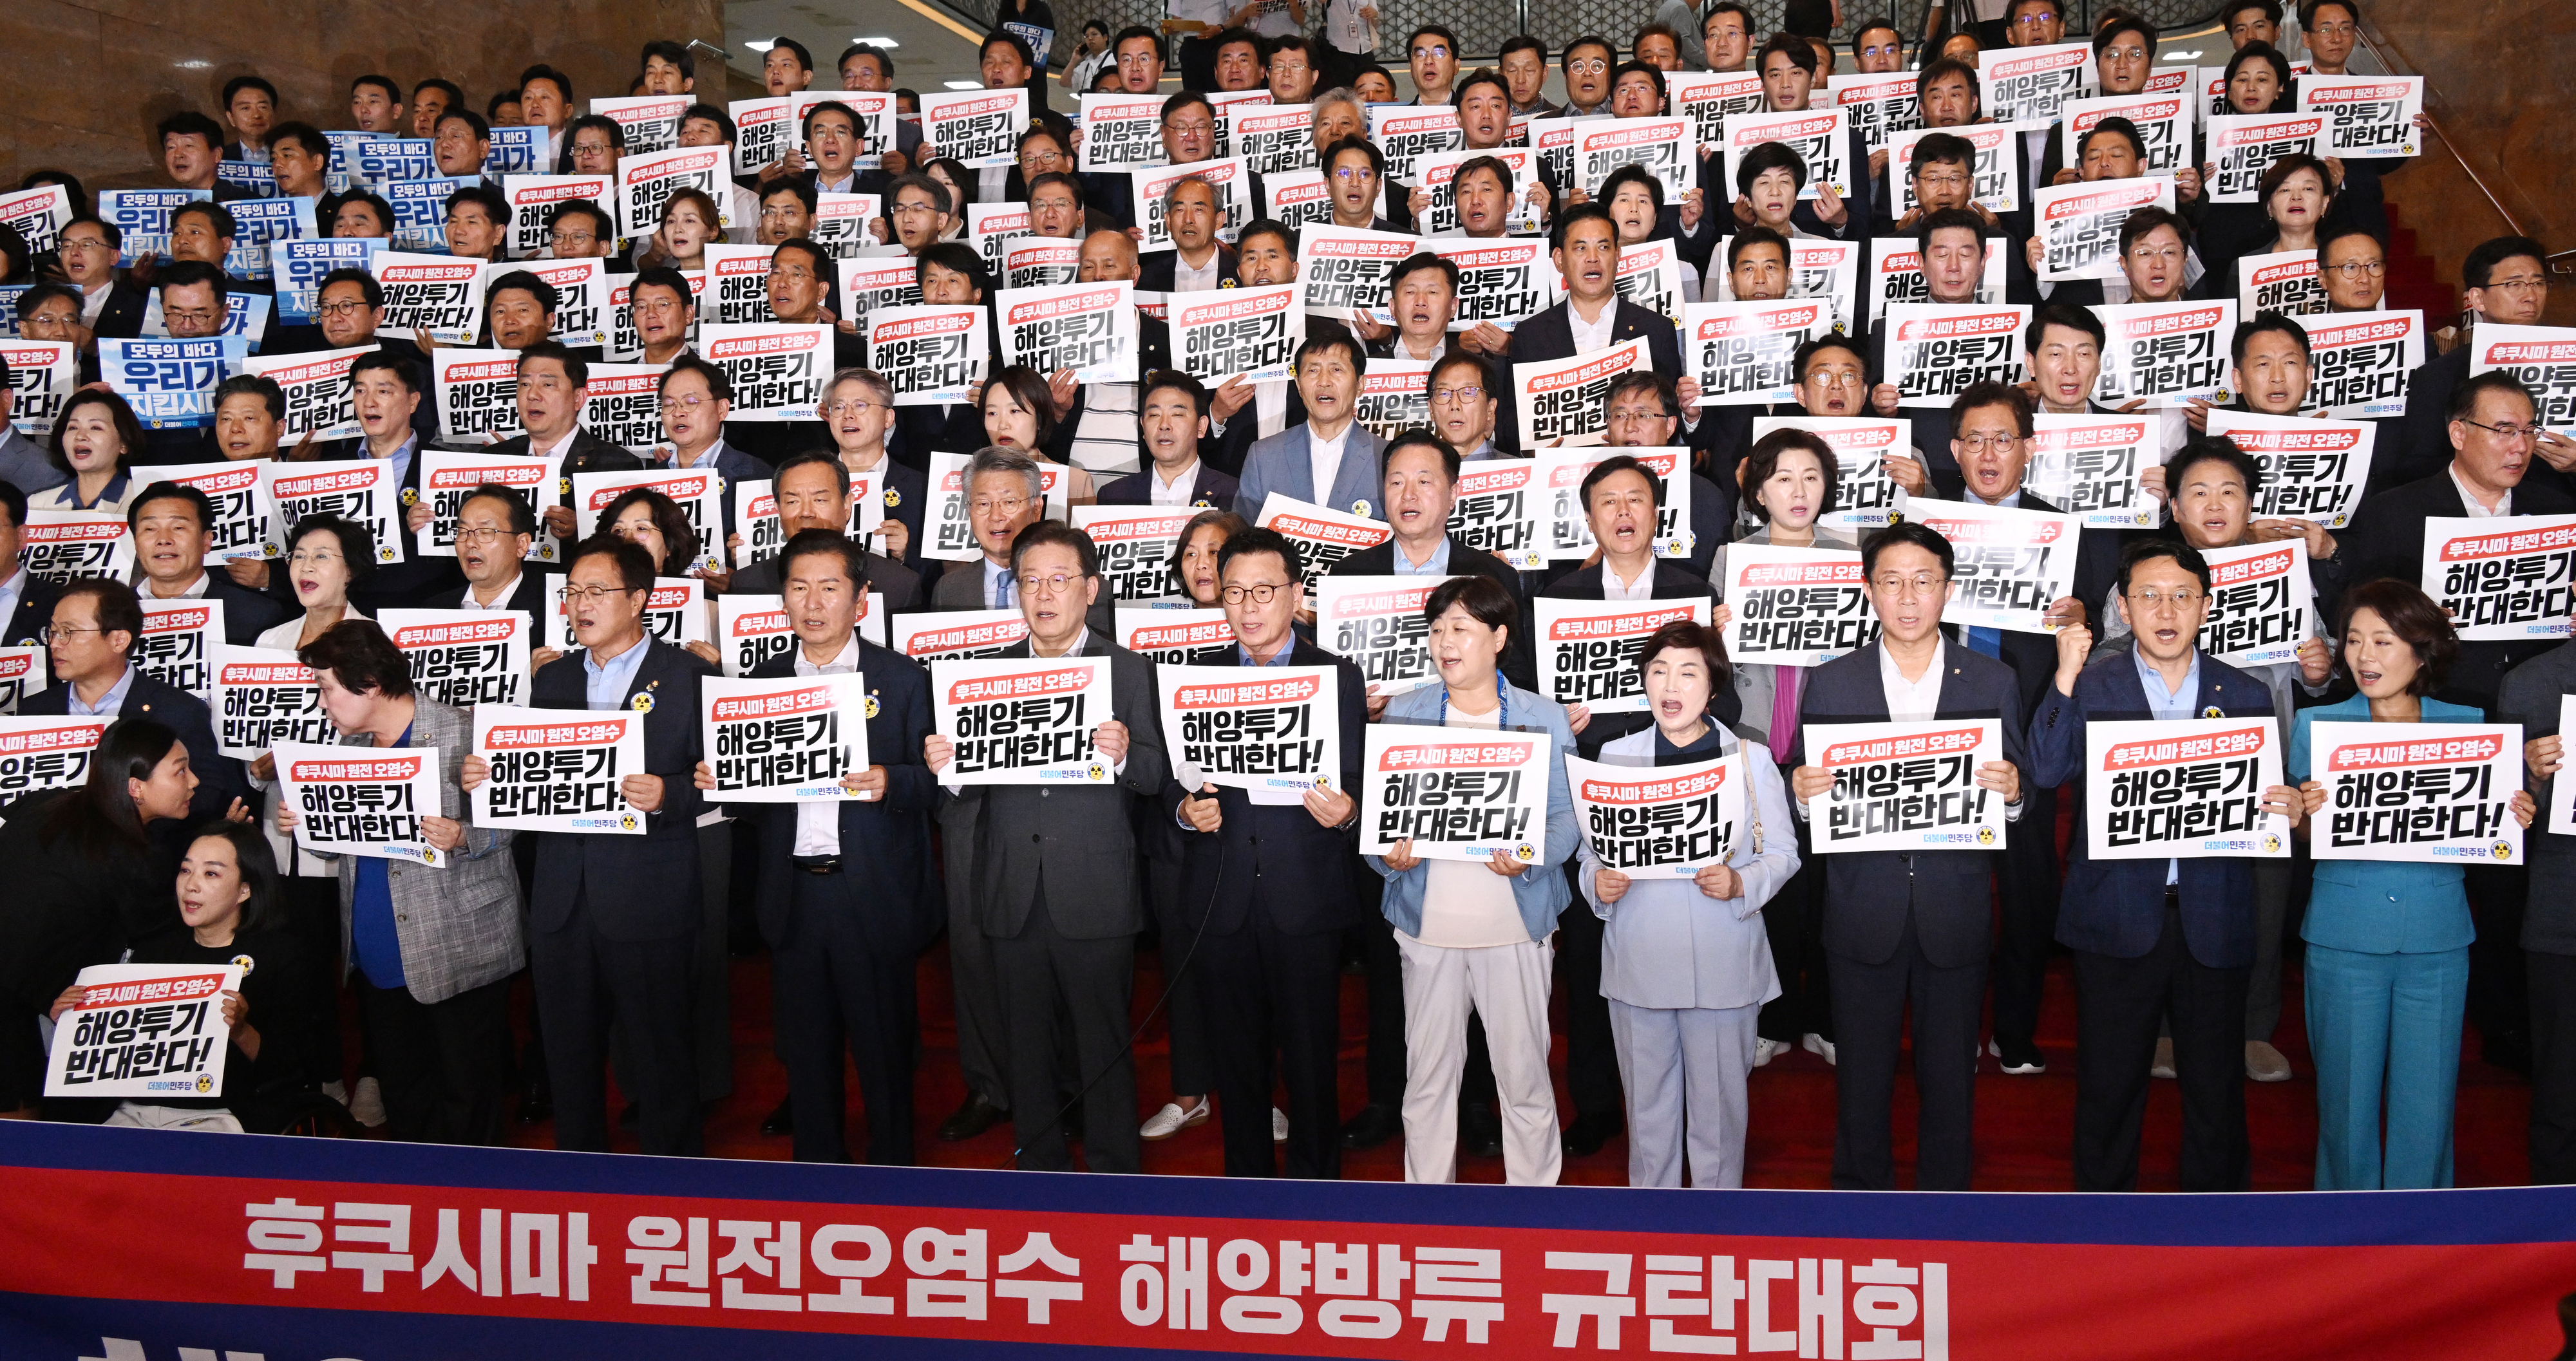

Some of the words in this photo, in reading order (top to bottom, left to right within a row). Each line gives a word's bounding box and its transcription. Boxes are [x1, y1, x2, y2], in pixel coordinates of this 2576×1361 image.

[1994, 60, 2033, 76] 후쿠시마
[2034, 56, 2053, 69] 원전
[2054, 52, 2083, 66] 오염수
[2313, 89, 2353, 101] 후쿠시마
[2354, 88, 2374, 99] 원전
[2374, 86, 2405, 97] 오염수
[934, 104, 969, 118] 후쿠시마
[970, 100, 987, 113] 원전
[988, 97, 1014, 109] 오염수
[503, 130, 527, 144] 바다
[935, 111, 1012, 143] 해양투기
[1589, 133, 1628, 148] 후쿠시마
[1629, 129, 1649, 142] 원전
[1650, 126, 1680, 139] 오염수
[2266, 126, 2286, 138] 원전
[2287, 122, 2317, 135] 오염수
[365, 143, 401, 156] 모두의
[403, 142, 427, 155] 바다
[361, 158, 435, 185] 우리가
[123, 194, 159, 207] 모두의
[162, 193, 188, 206] 바다
[394, 183, 422, 198] 모두의
[429, 182, 455, 195] 바다
[231, 204, 263, 218] 모두의
[265, 203, 290, 216] 바다
[294, 243, 330, 258] 모두의
[333, 242, 362, 256] 바다
[1314, 242, 1356, 254] 후쿠시마
[1358, 243, 1378, 254] 원전
[1378, 243, 1409, 255] 오염수
[386, 268, 424, 279] 후쿠시마
[424, 267, 444, 279] 원전
[444, 267, 472, 278] 오염수
[381, 283, 469, 306] 해양투기
[1057, 297, 1080, 312] 원전
[1081, 292, 1115, 308] 오염수
[1186, 305, 1230, 323] 후쿠시마
[1231, 301, 1253, 315] 원전
[1255, 295, 1287, 311] 오염수
[875, 323, 912, 340] 후쿠시마
[913, 319, 934, 333] 원전
[936, 316, 969, 330] 오염수
[1186, 312, 1285, 353] 해양투기
[1955, 319, 1979, 333] 원전
[1980, 316, 2015, 330] 오염수
[2344, 326, 2369, 342] 원전
[2371, 322, 2406, 338] 오염수
[19, 352, 54, 363] 오염수
[131, 344, 179, 358] 모두의
[184, 342, 217, 357] 바다
[715, 340, 757, 355] 후쿠시마
[758, 337, 780, 350] 원전
[781, 335, 815, 348] 오염수
[875, 333, 967, 369] 해양투기
[1186, 337, 1296, 381] 반대한다!
[124, 359, 231, 392] 우리가
[1533, 371, 1578, 390] 후쿠시마
[1579, 363, 1601, 380] 원전
[83, 525, 121, 537] 오염수
[2449, 538, 2509, 557] 후쿠시마
[2510, 533, 2539, 550] 원전
[1747, 567, 1803, 583] 후쿠시마
[1804, 566, 1832, 581] 원전
[2221, 563, 2248, 582] 원전
[2251, 554, 2289, 576] 오염수
[1743, 586, 1871, 619] 해양투기
[400, 628, 448, 644] 후쿠시마
[450, 625, 473, 640] 원전
[475, 623, 510, 638] 오염수
[956, 679, 1012, 699] 후쿠시마
[1014, 676, 1042, 693] 원전
[1044, 671, 1087, 690] 오염수
[1180, 688, 1235, 705] 후쿠시마
[1237, 685, 1266, 702] 원전
[1268, 680, 1312, 699] 오염수
[716, 699, 764, 717] 후쿠시마
[766, 695, 794, 713] 원전
[796, 689, 840, 709] 오염수
[957, 694, 1084, 737] 해양투기
[491, 729, 545, 746] 후쿠시마
[547, 727, 574, 743] 원전
[576, 724, 620, 741] 오염수
[715, 712, 837, 756] 해양투기
[1182, 706, 1310, 743] 해양투기
[956, 728, 1097, 773] 반대한다!
[1387, 749, 1447, 766] 후쿠시마
[1449, 747, 1479, 764] 원전
[1480, 747, 1525, 763] 오염수
[1830, 742, 1893, 762] 후쿠시마
[1895, 737, 1926, 755] 원전
[1928, 733, 1975, 751] 오염수
[2113, 743, 2178, 765] 후쿠시마
[2180, 738, 2212, 758] 원전
[2215, 733, 2260, 754] 오염수
[2338, 746, 2405, 766] 후쿠시마
[2408, 743, 2441, 761] 원전
[2444, 740, 2495, 758] 오염수
[296, 764, 346, 778] 후쿠시마
[347, 764, 373, 778] 원전
[374, 762, 414, 777] 오염수
[491, 747, 616, 783] 해양투기
[715, 746, 851, 791] 반대한다!
[1830, 754, 1972, 800] 해양투기
[796, 787, 841, 796] 더불어민주당
[1267, 779, 1311, 789] 더불어민주당
[1383, 770, 1520, 806] 해양투기
[1587, 783, 1641, 800] 후쿠시마
[1642, 782, 1672, 800] 원전
[1676, 773, 1719, 795] 오염수
[2112, 758, 2259, 807] 해양투기
[2336, 765, 2491, 808] 해양투기
[301, 783, 414, 812] 해양투기
[489, 781, 629, 817] 반대한다!
[1378, 807, 1531, 843] 반대한다!
[1589, 793, 1718, 838] 해양투기
[1829, 788, 1987, 840] 반대한다!
[2332, 803, 2505, 847] 반대한다!
[384, 846, 422, 856] 더불어민주당
[1591, 820, 1732, 868] 반대한다!
[1924, 834, 1973, 843] 더불어민주당
[2204, 841, 2256, 850] 더불어민주당
[2433, 847, 2486, 856] 더불어민주당
[82, 985, 140, 1006] 후쿠시마
[140, 982, 171, 999] 원전
[170, 979, 215, 996] 오염수
[73, 1001, 207, 1046] 해양투기
[64, 1037, 214, 1084] 반대한다!
[147, 1082, 192, 1090] 더불어민주당
[244, 1197, 597, 1301] 후쿠시마
[626, 1216, 1083, 1324] 원전오염수
[1120, 1234, 1504, 1344] 해양방류
[1542, 1252, 1948, 1361] 규탄대회
